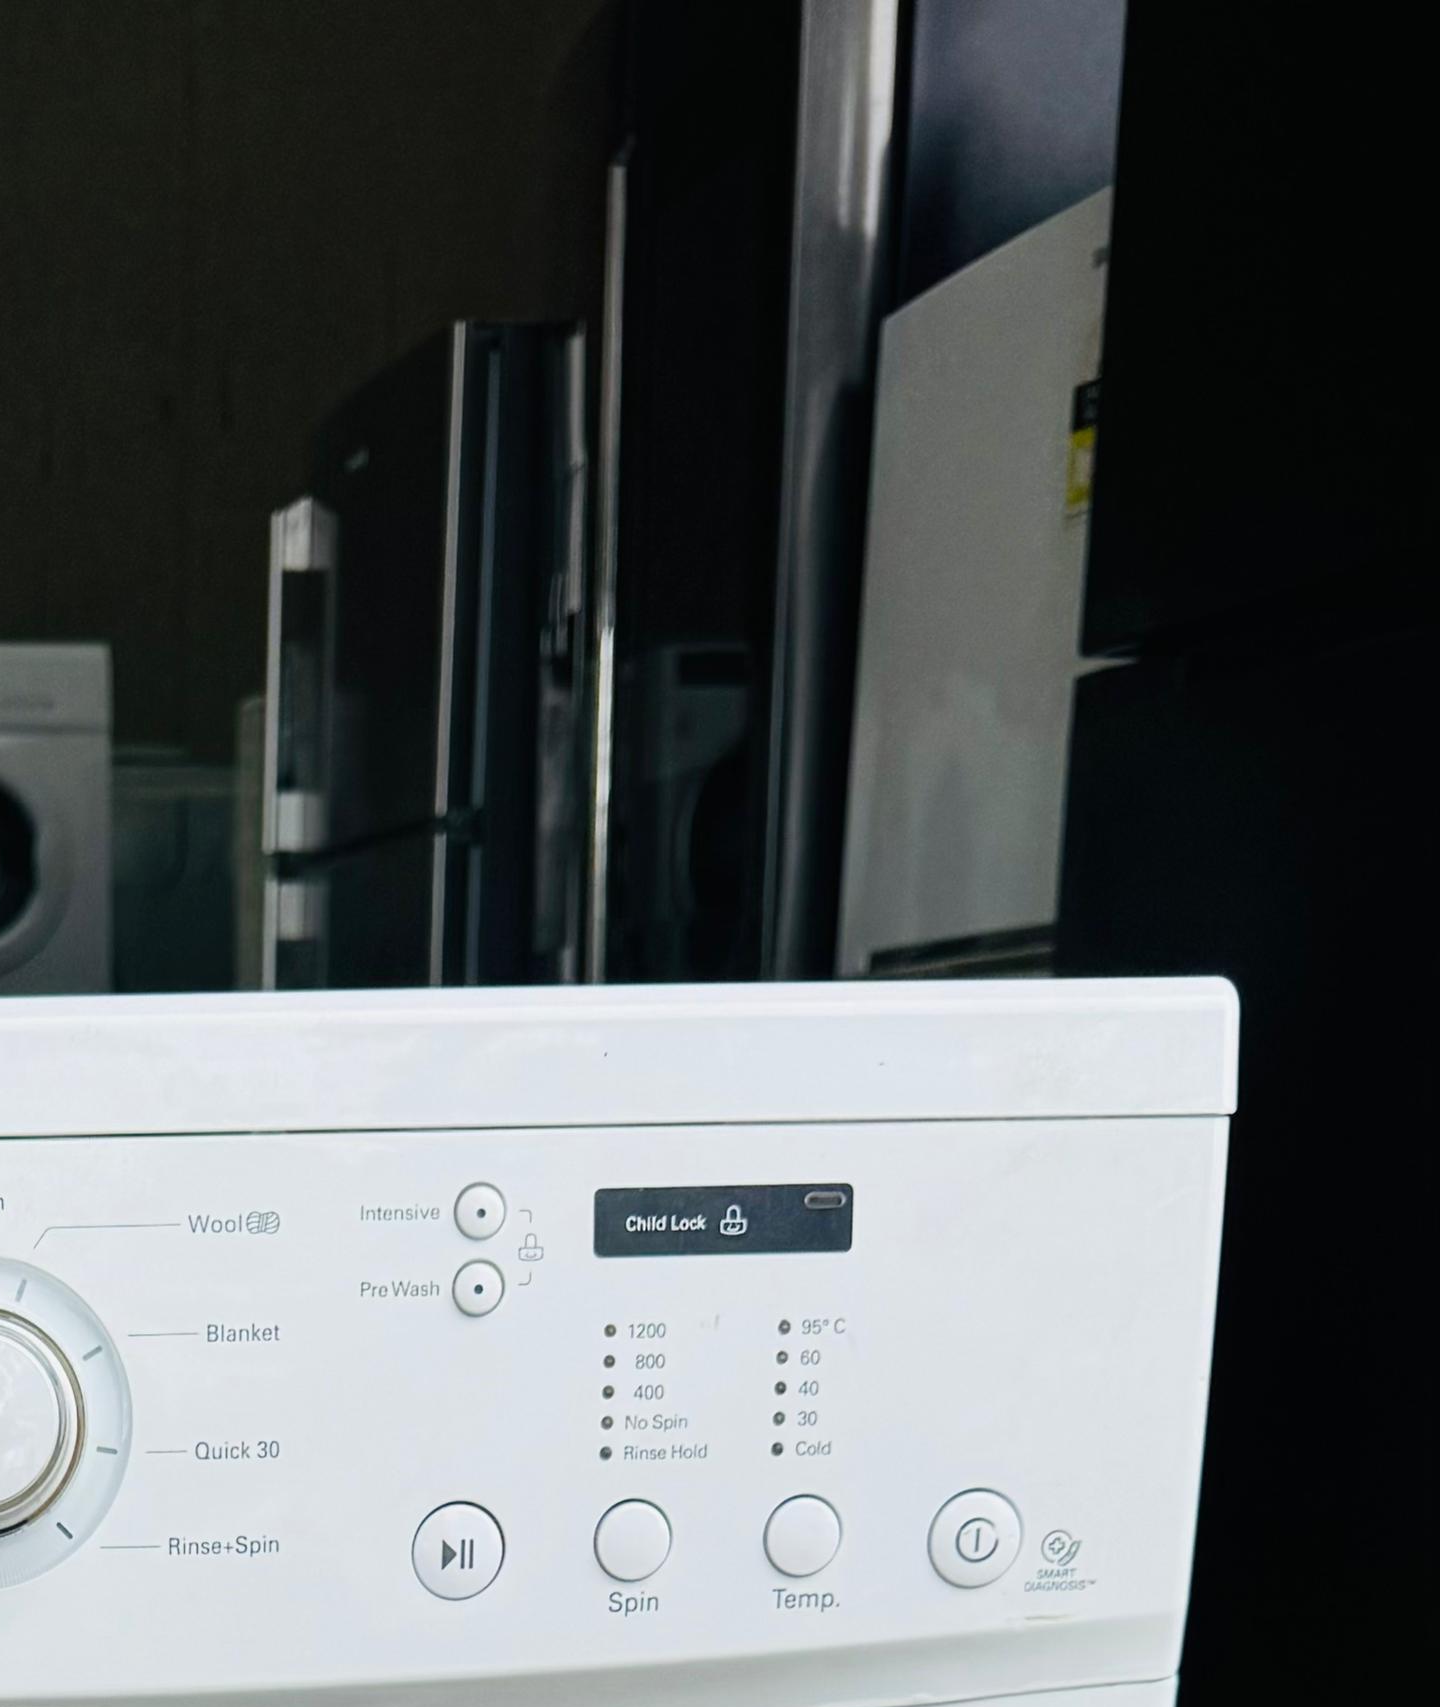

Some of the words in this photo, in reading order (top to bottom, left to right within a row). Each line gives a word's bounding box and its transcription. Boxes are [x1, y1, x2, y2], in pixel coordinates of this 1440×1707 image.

[361, 1204, 440, 1221] Intensive
[188, 1214, 242, 1233] Wool
[626, 1216, 666, 1231] Child
[671, 1215, 706, 1230] Lock
[361, 1282, 388, 1297] Pre
[392, 1281, 439, 1296] Wash
[207, 1323, 279, 1342] Blanket
[629, 1323, 666, 1338] 1200
[636, 1354, 665, 1369] 800
[800, 1350, 820, 1365] 60
[634, 1385, 664, 1400] 400
[799, 1381, 819, 1396] 40
[625, 1416, 648, 1430] No
[653, 1414, 687, 1432] Spin
[798, 1411, 817, 1426] 30
[195, 1442, 250, 1460] Quick
[257, 1441, 279, 1458] 30
[624, 1446, 666, 1460] Rinse
[672, 1444, 707, 1459] Hold
[796, 1441, 832, 1456] Cold
[169, 1536, 279, 1557] Rinse+Spin
[1037, 1569, 1076, 1579] SMART
[609, 1592, 658, 1616] Spin
[772, 1588, 839, 1612] Temp.
